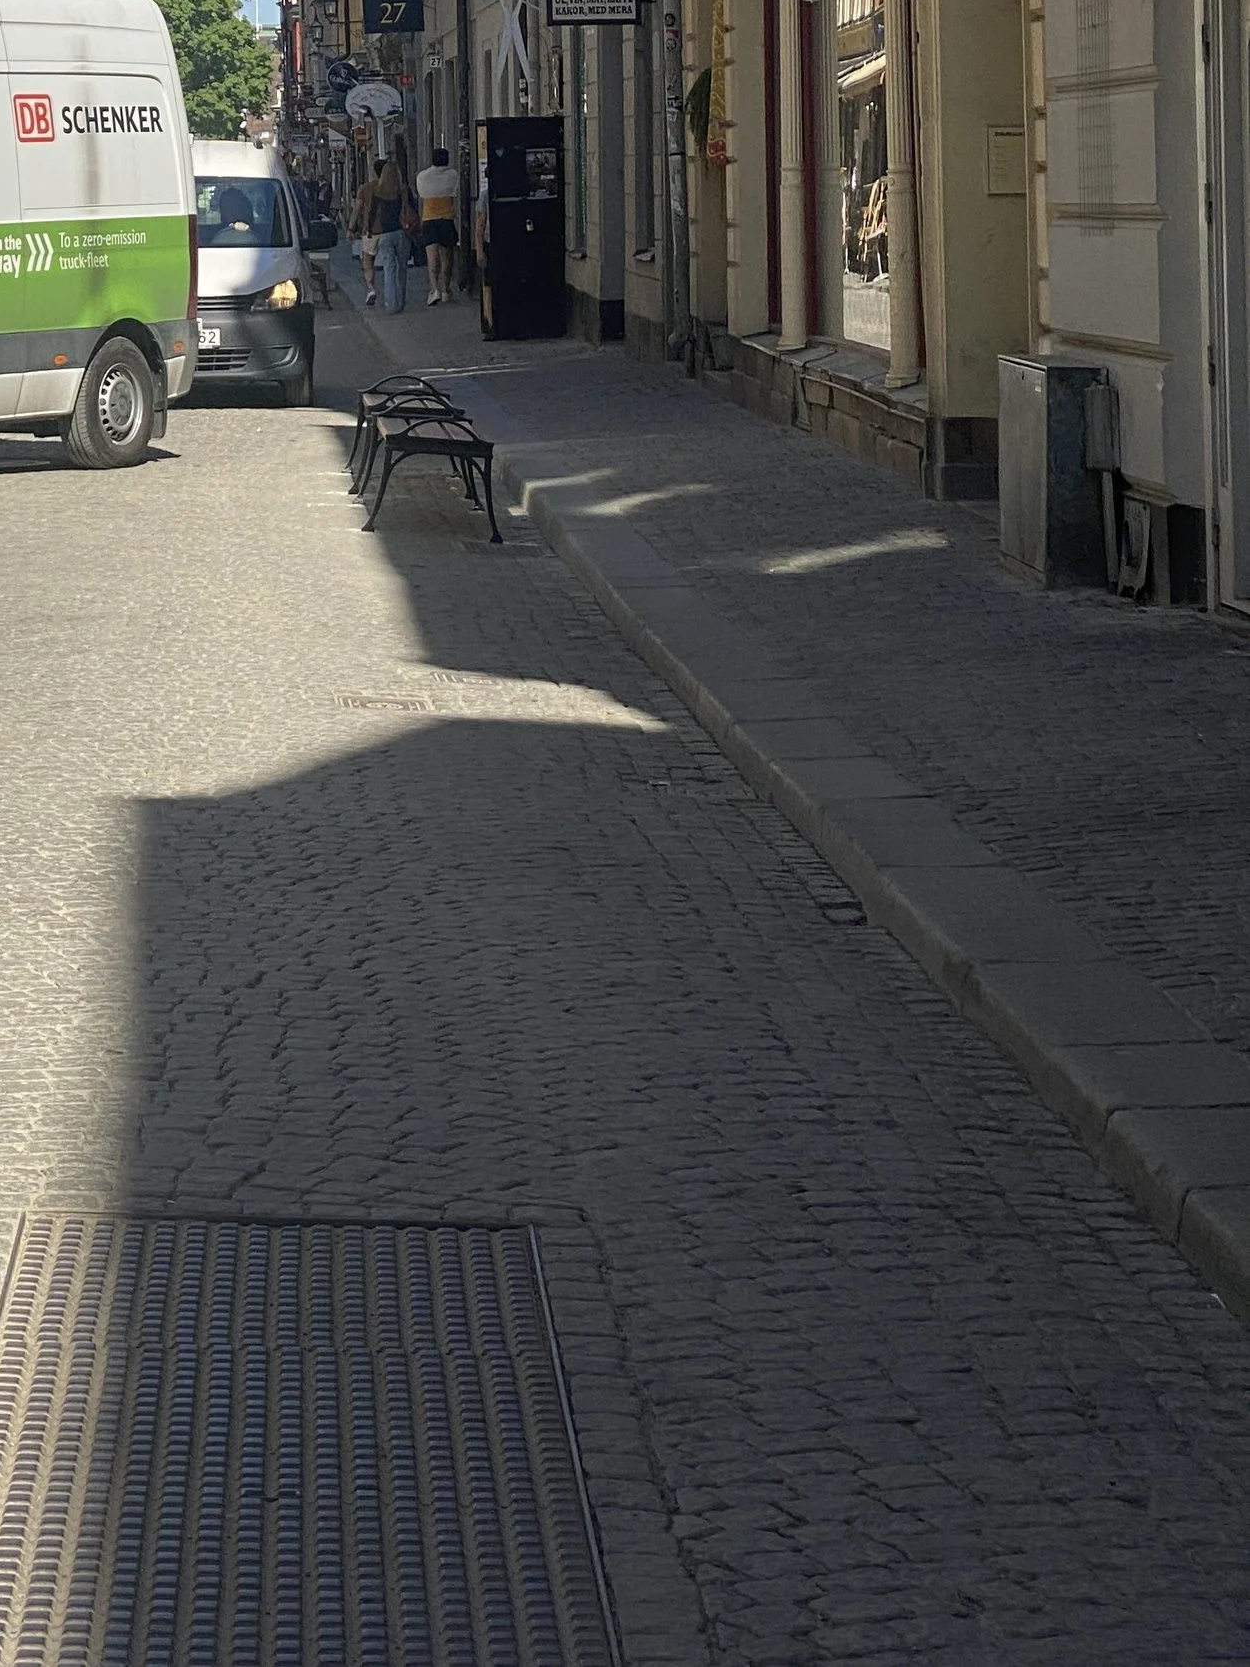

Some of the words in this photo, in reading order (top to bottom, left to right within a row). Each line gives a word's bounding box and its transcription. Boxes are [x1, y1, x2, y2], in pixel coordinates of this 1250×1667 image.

[380, 2, 407, 24] 27
[588, 6, 607, 14] MED
[608, 5, 633, 14] MERA
[431, 57, 440, 66] 27
[18, 101, 52, 135] DB
[61, 105, 163, 134] SCHENKER
[4, 234, 22, 251] the
[59, 232, 71, 248] To
[73, 236, 80, 248] a
[82, 229, 146, 247] zero-emission
[59, 252, 109, 270] truck-fleet
